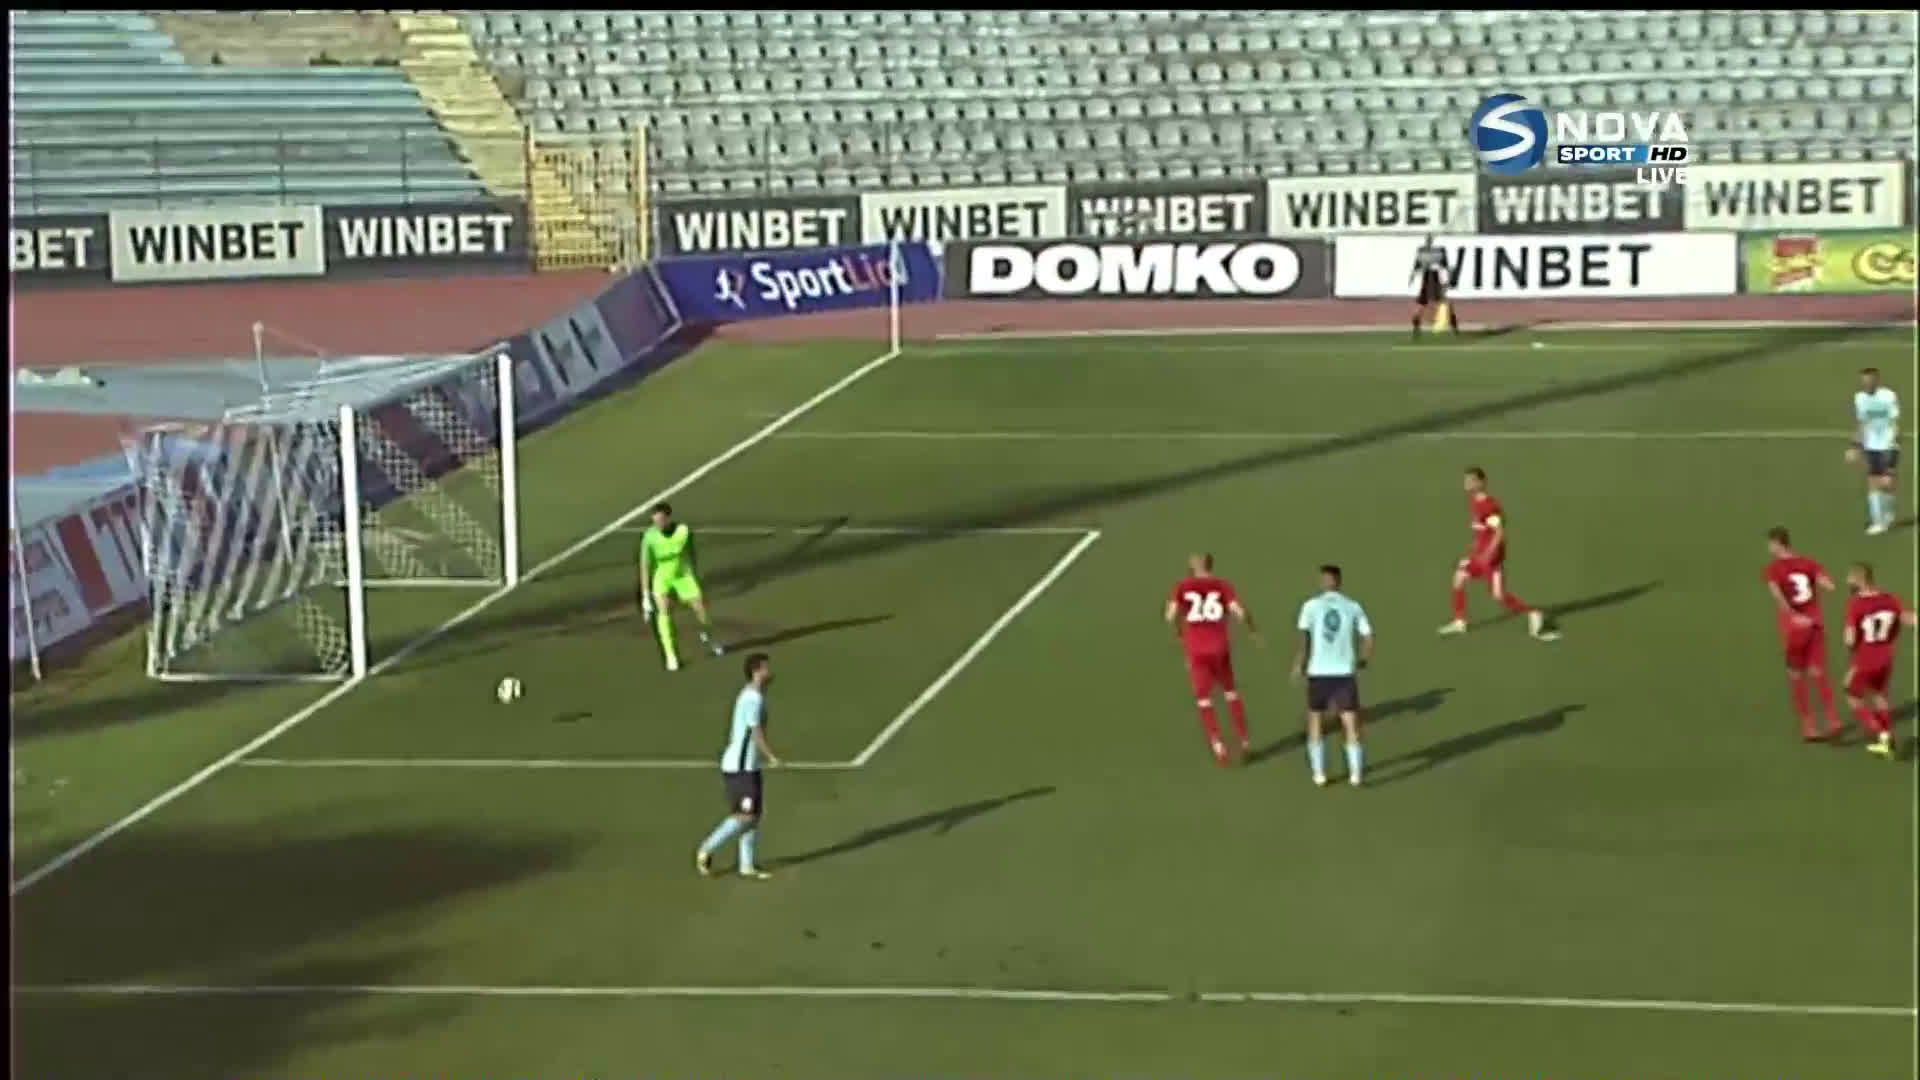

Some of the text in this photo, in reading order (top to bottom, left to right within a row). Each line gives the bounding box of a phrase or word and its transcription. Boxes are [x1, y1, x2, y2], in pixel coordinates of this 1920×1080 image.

[1081, 193, 1254, 236] WINBET
[1287, 189, 1457, 228] WINBET
[1491, 183, 1667, 223] WINBET
[1705, 176, 1883, 217] WINBET
[339, 213, 513, 259] WINBET
[675, 208, 846, 251] WINBET
[880, 201, 1047, 241] WINBET
[129, 220, 304, 264] WINBET
[970, 242, 1300, 295] DOMKO
[1184, 591, 1224, 622] 26
[1788, 572, 1813, 603] 3
[1323, 608, 1342, 644] 9
[1861, 610, 1896, 643] 17
